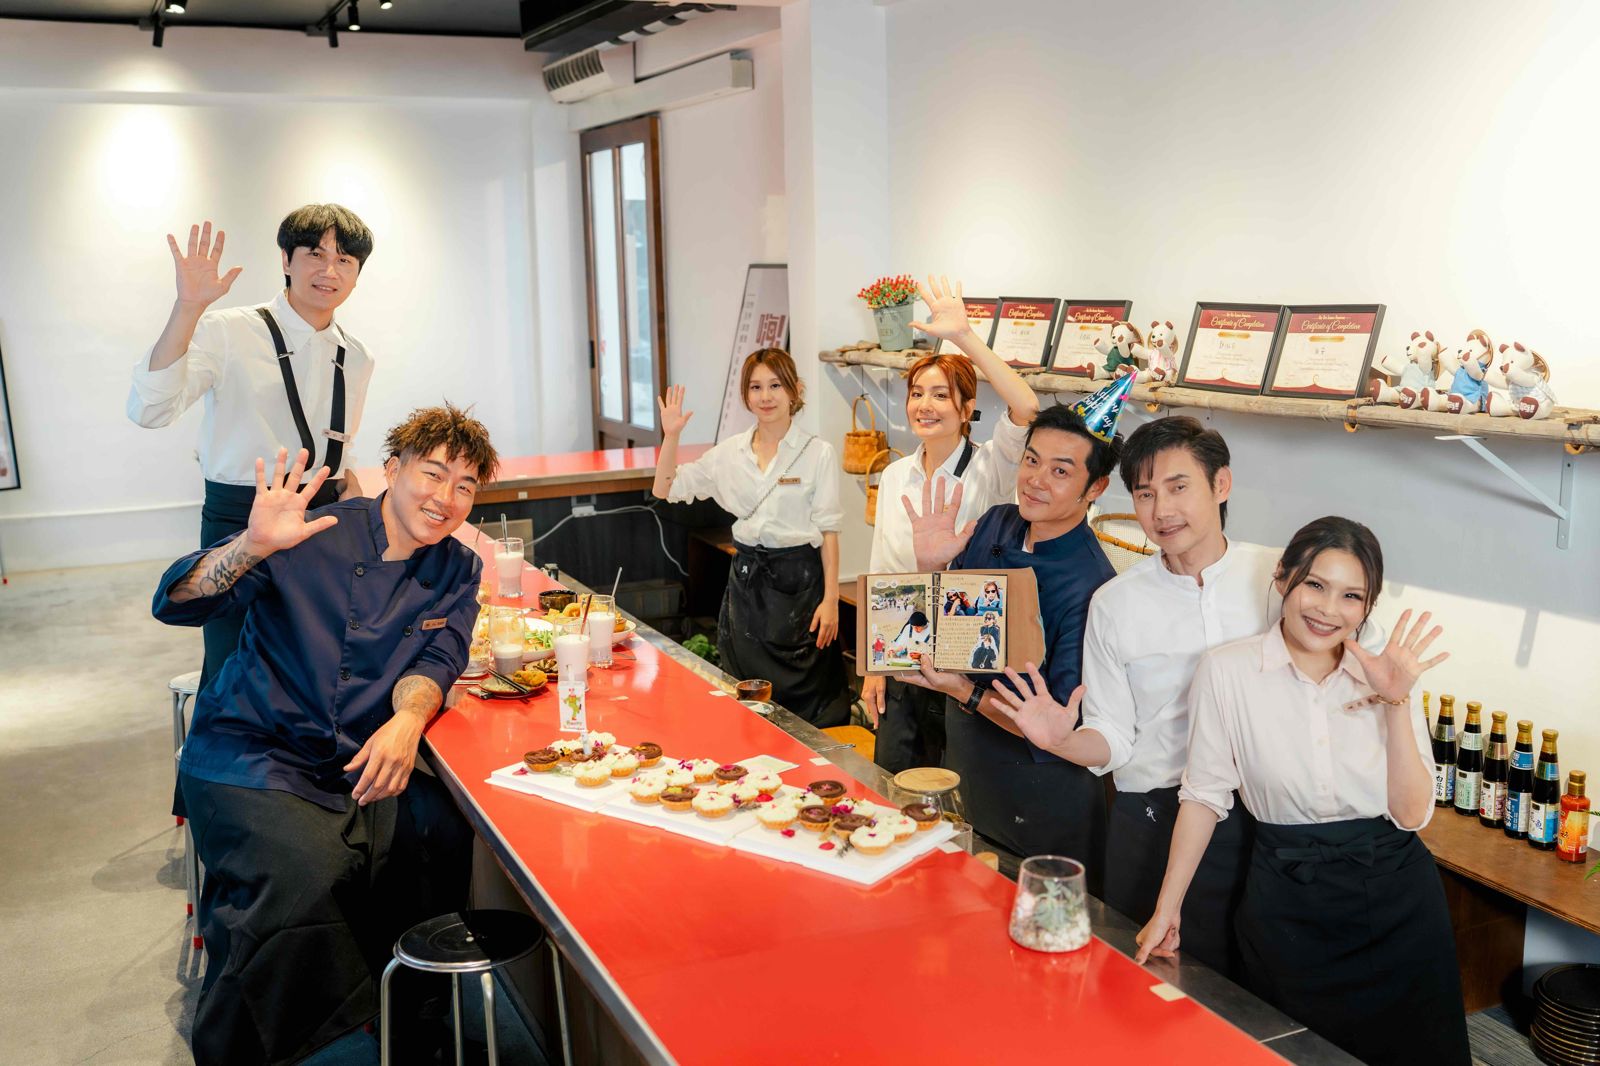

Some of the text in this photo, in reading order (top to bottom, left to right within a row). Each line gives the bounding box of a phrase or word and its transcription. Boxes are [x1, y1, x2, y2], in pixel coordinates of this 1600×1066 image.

[1008, 308, 1023, 319] Certificate
[1026, 309, 1045, 319] Completion
[1074, 312, 1092, 323] Certificate
[1095, 312, 1115, 323] Completion
[1210, 316, 1233, 329] Certificate
[1238, 317, 1265, 330] Completion
[1301, 319, 1326, 332] Certificate
[1331, 320, 1361, 332] Completion
